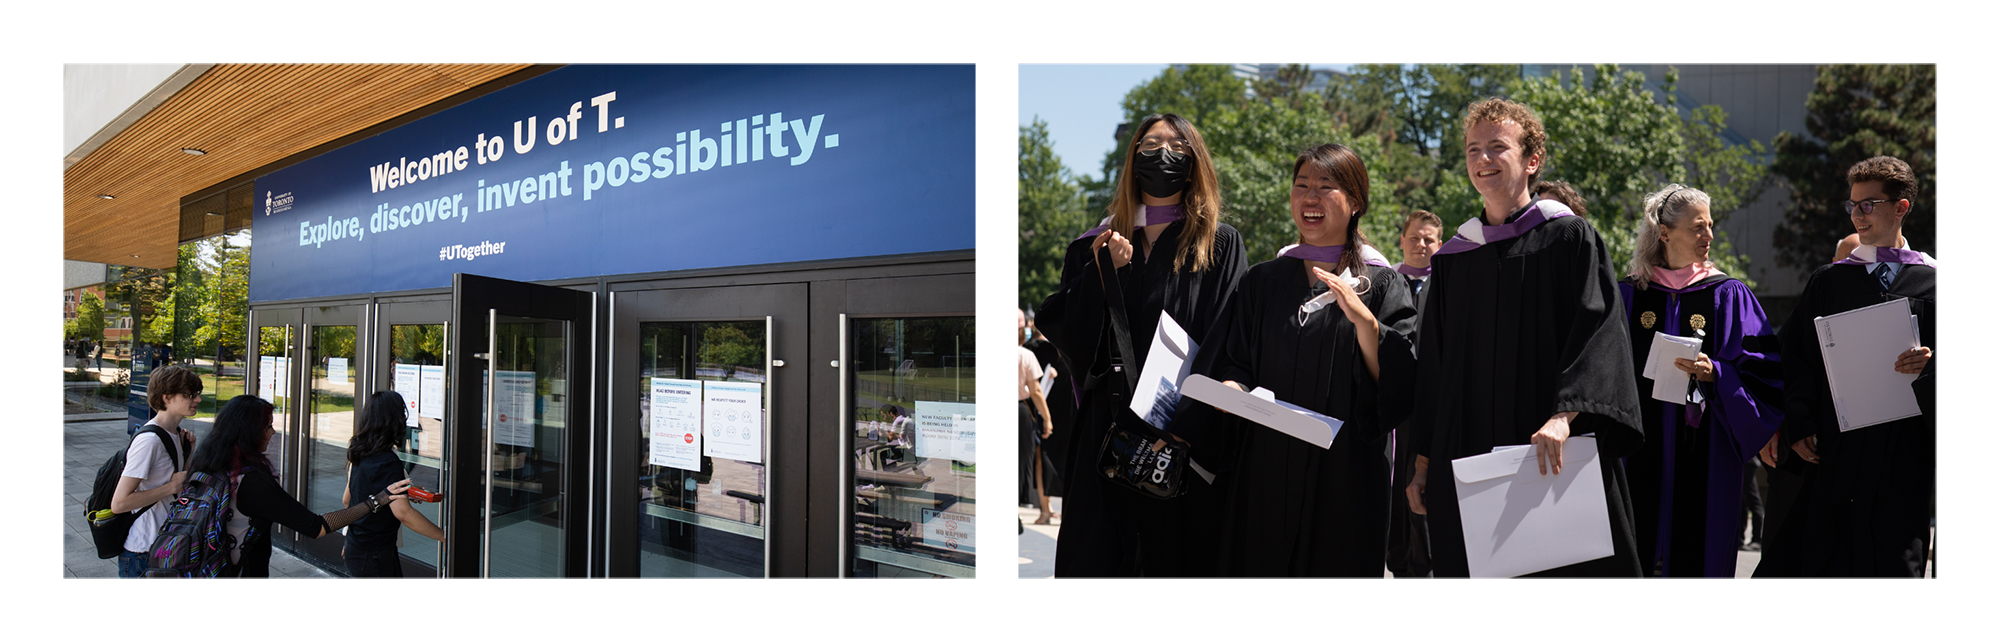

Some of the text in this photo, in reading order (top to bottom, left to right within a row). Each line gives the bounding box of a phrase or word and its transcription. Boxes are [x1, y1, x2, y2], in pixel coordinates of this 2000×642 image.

[370, 91, 625, 194] Welcome to U of T.
[299, 112, 840, 249] Explore, discover, invent possibility.
[272, 196, 294, 208] TORONTO
[439, 240, 506, 262] #UTogether
[1139, 443, 1153, 465] WELTMA
[942, 513, 970, 522] SMOKING
[945, 530, 967, 539] VAPING
